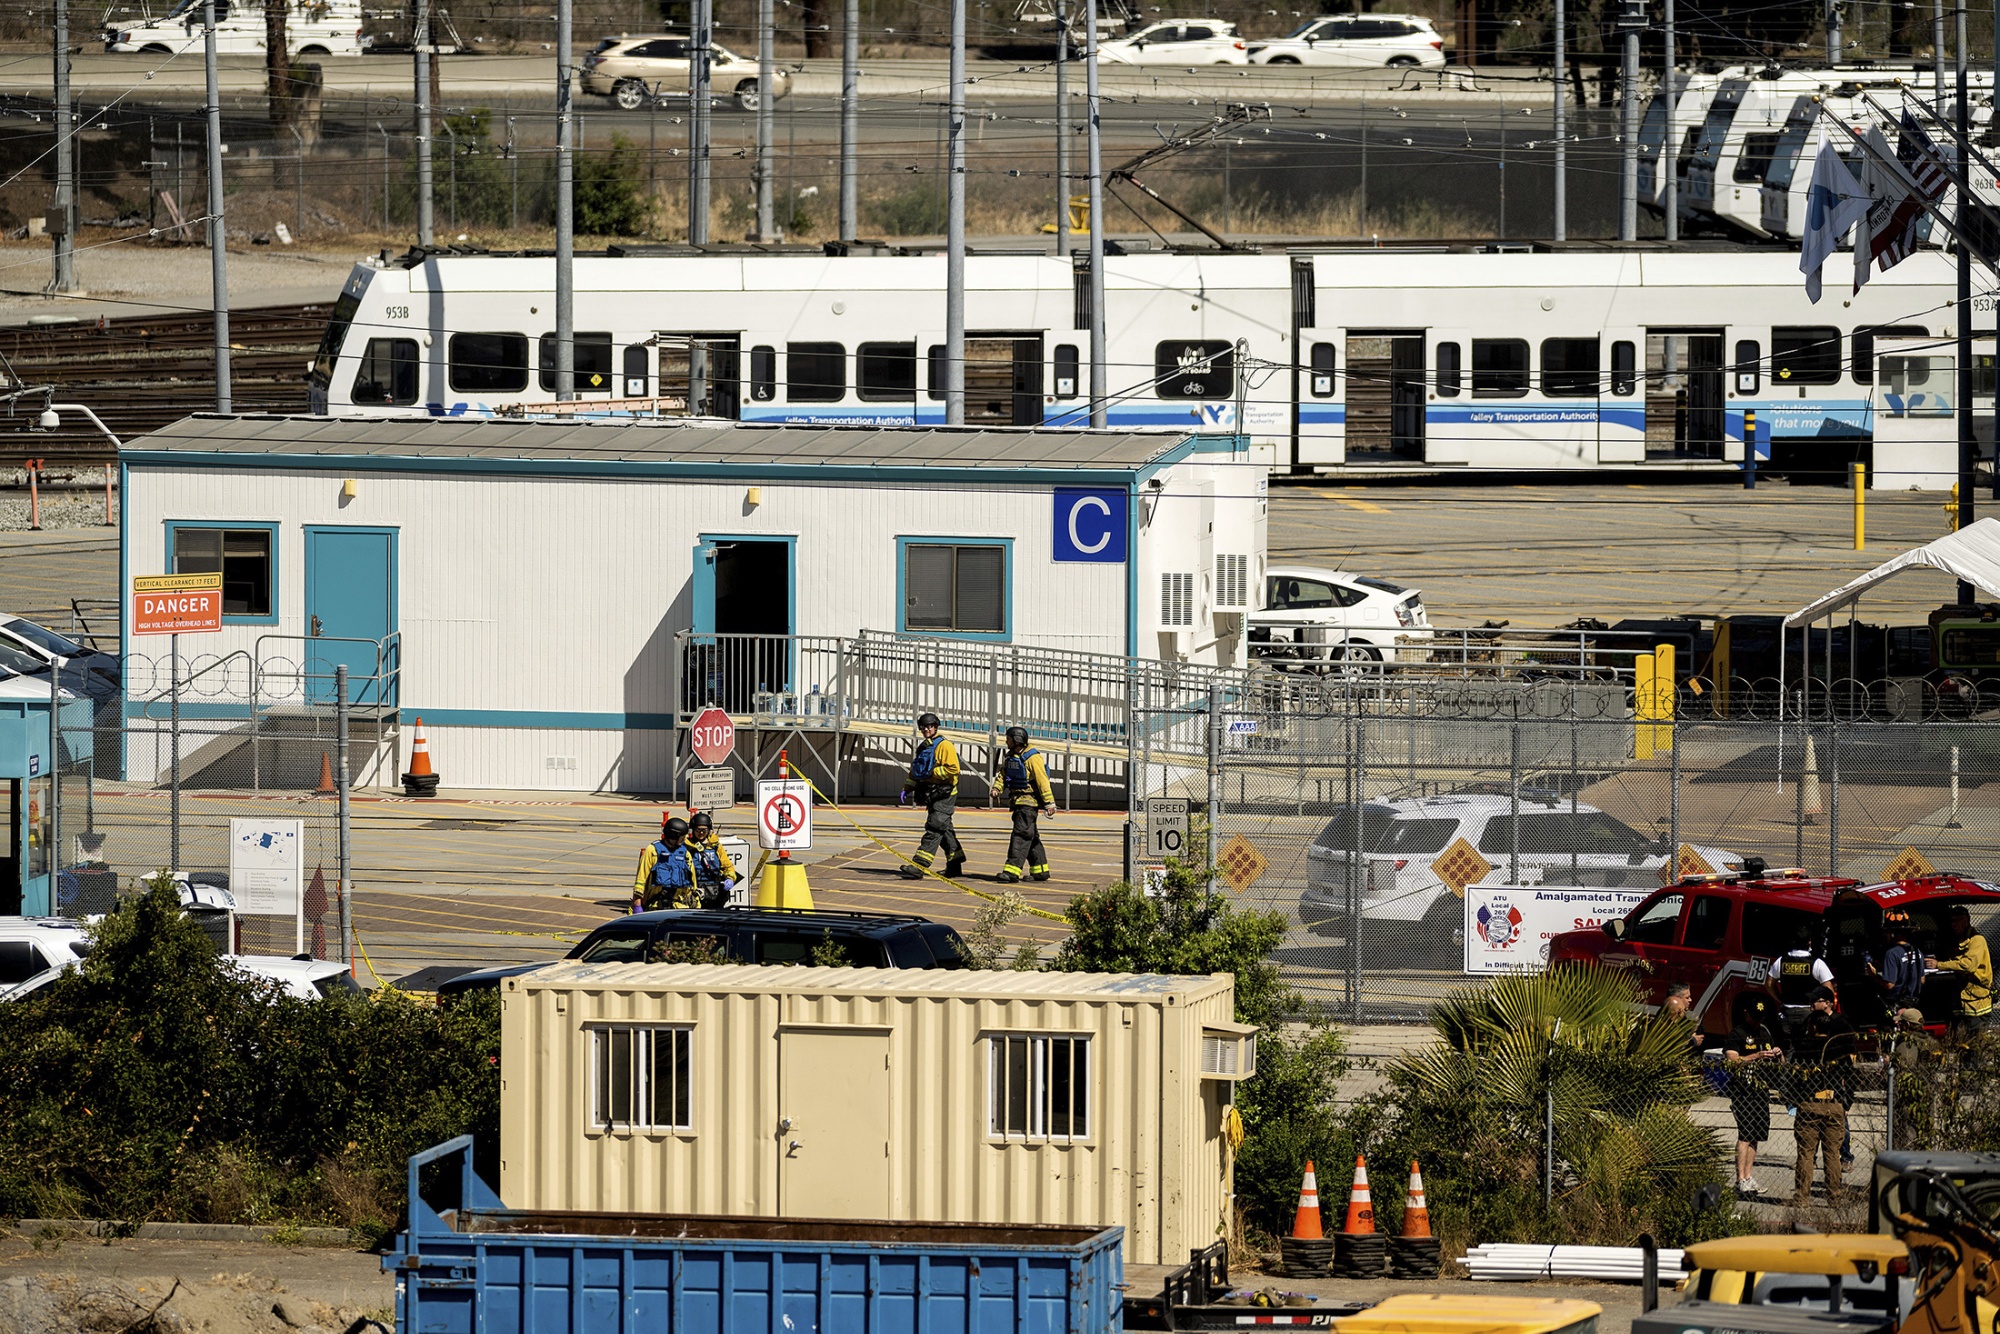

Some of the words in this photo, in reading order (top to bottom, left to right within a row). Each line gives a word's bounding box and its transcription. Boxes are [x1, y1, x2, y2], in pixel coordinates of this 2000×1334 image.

[386, 305, 409, 319] 953B
[1495, 412, 1559, 424] Transportation
[1774, 417, 1798, 429] that
[1800, 418, 1834, 429] move
[1836, 418, 1860, 431] you
[1068, 496, 1111, 554] C
[136, 580, 162, 588] VERTICAL
[164, 578, 195, 587] CLEARANCE
[203, 577, 217, 585] FEET
[144, 597, 209, 615] DANGER
[175, 620, 201, 628] OVERHEAD
[1240, 722, 1256, 732] AAA
[694, 725, 733, 748] STOP
[1152, 804, 1186, 813] SPEED
[1156, 817, 1181, 826] LIMIT
[1156, 829, 1181, 851] 10
[1535, 892, 1612, 903] Amalgamated
[1620, 959, 1634, 970] SAN
[1636, 958, 1655, 975] JOSE
[1749, 959, 1768, 981] B5
[1784, 963, 1807, 974] SHERIFF
[1311, 1315, 1331, 1326] PJ
